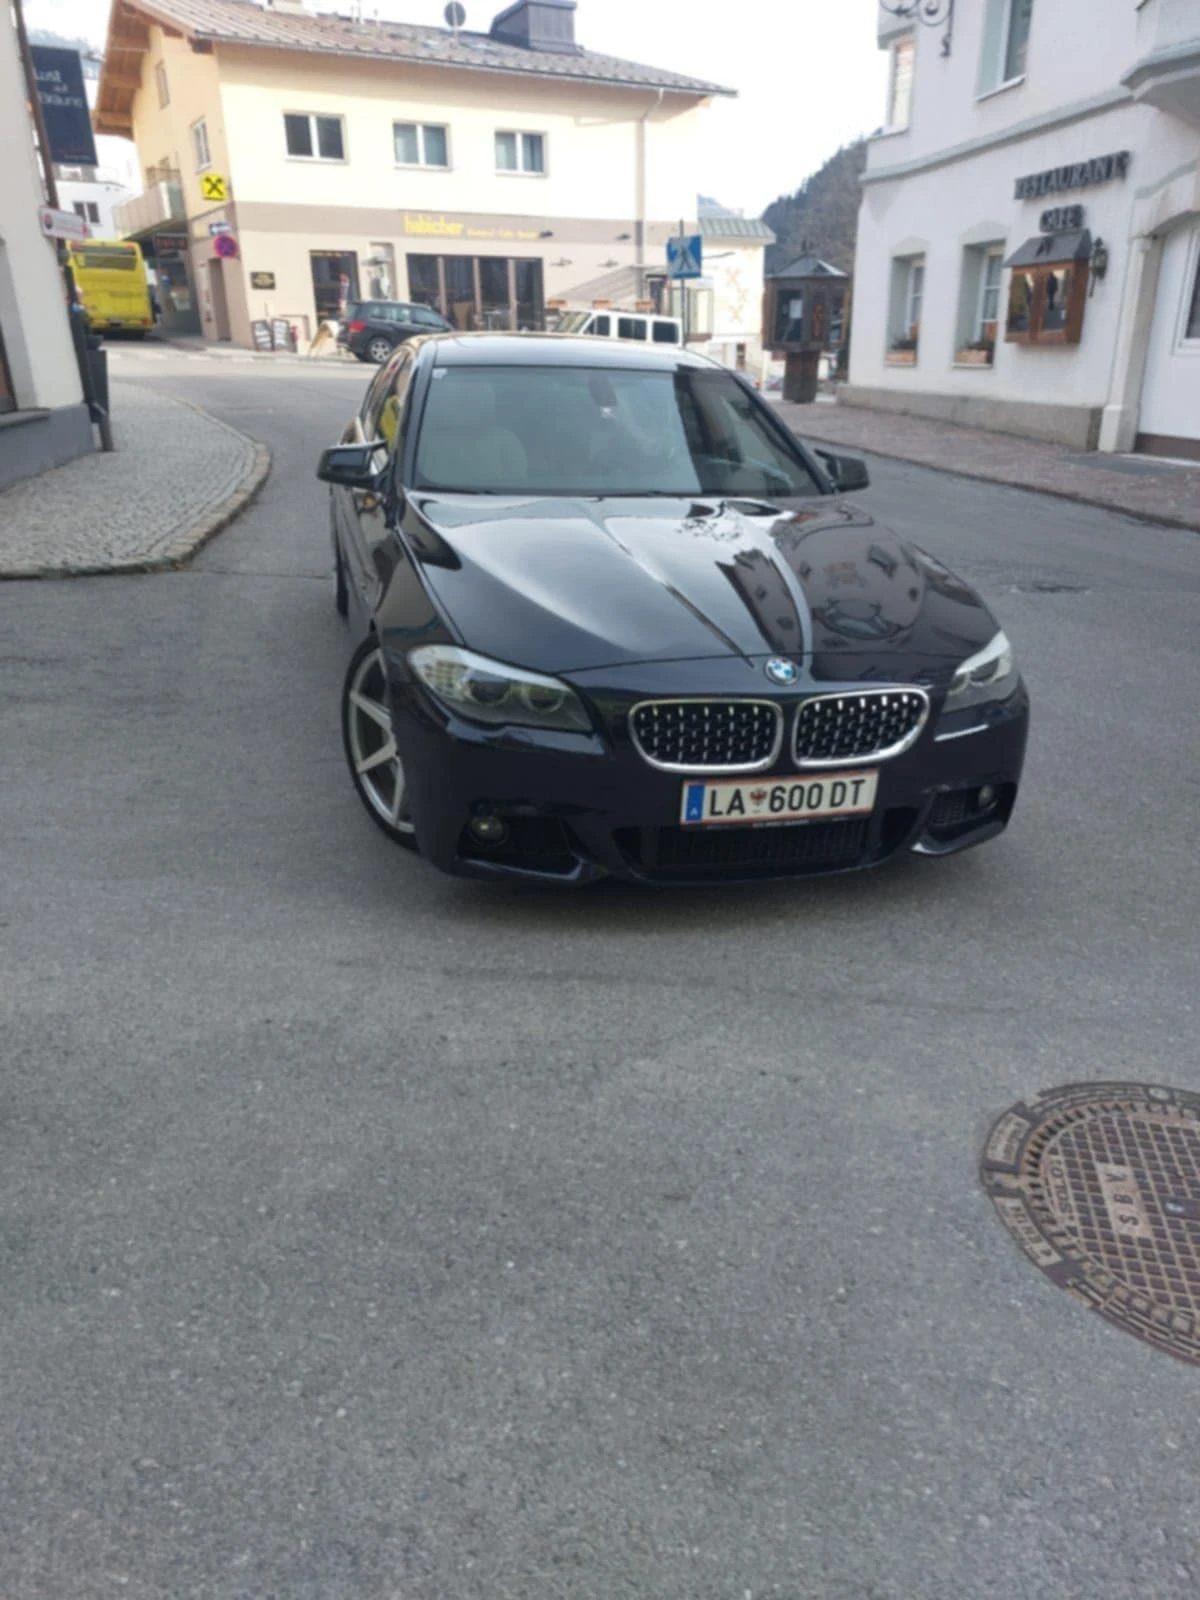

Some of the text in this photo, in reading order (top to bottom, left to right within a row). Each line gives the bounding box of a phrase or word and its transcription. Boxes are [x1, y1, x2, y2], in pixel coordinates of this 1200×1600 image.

[709, 779, 866, 816] LA 600 DT
[690, 807, 699, 817] A
